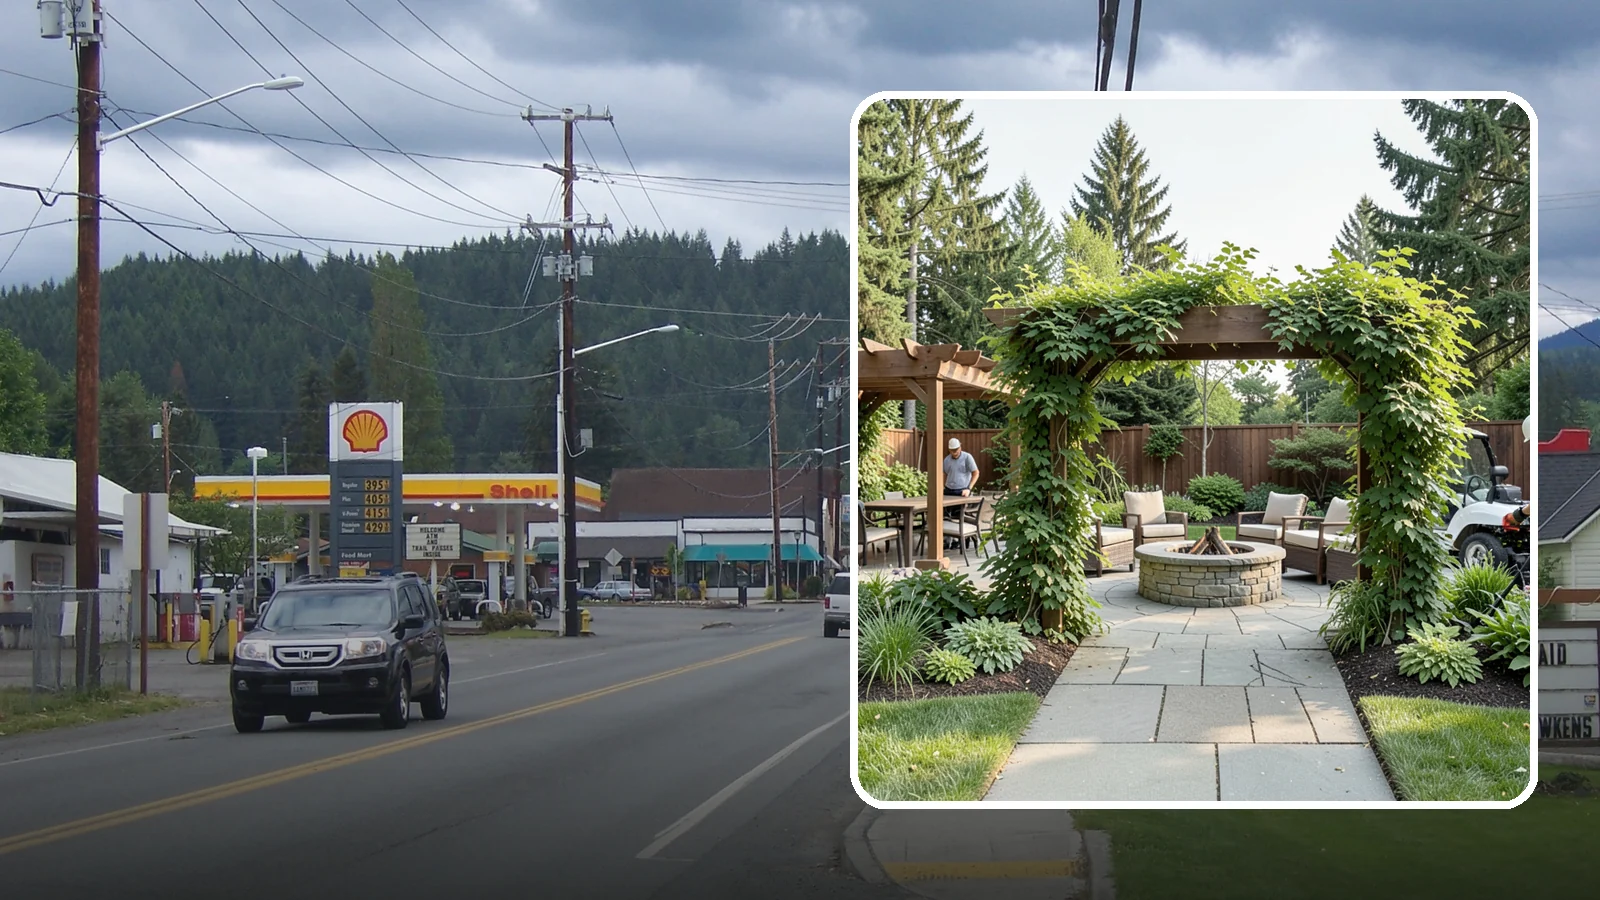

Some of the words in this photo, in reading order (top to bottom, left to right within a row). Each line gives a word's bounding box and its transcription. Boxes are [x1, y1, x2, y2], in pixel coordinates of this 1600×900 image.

[365, 480, 384, 491] 395
[490, 484, 547, 499] Shell
[365, 493, 384, 505] 405
[365, 507, 384, 519] 415
[365, 521, 384, 533] 429
